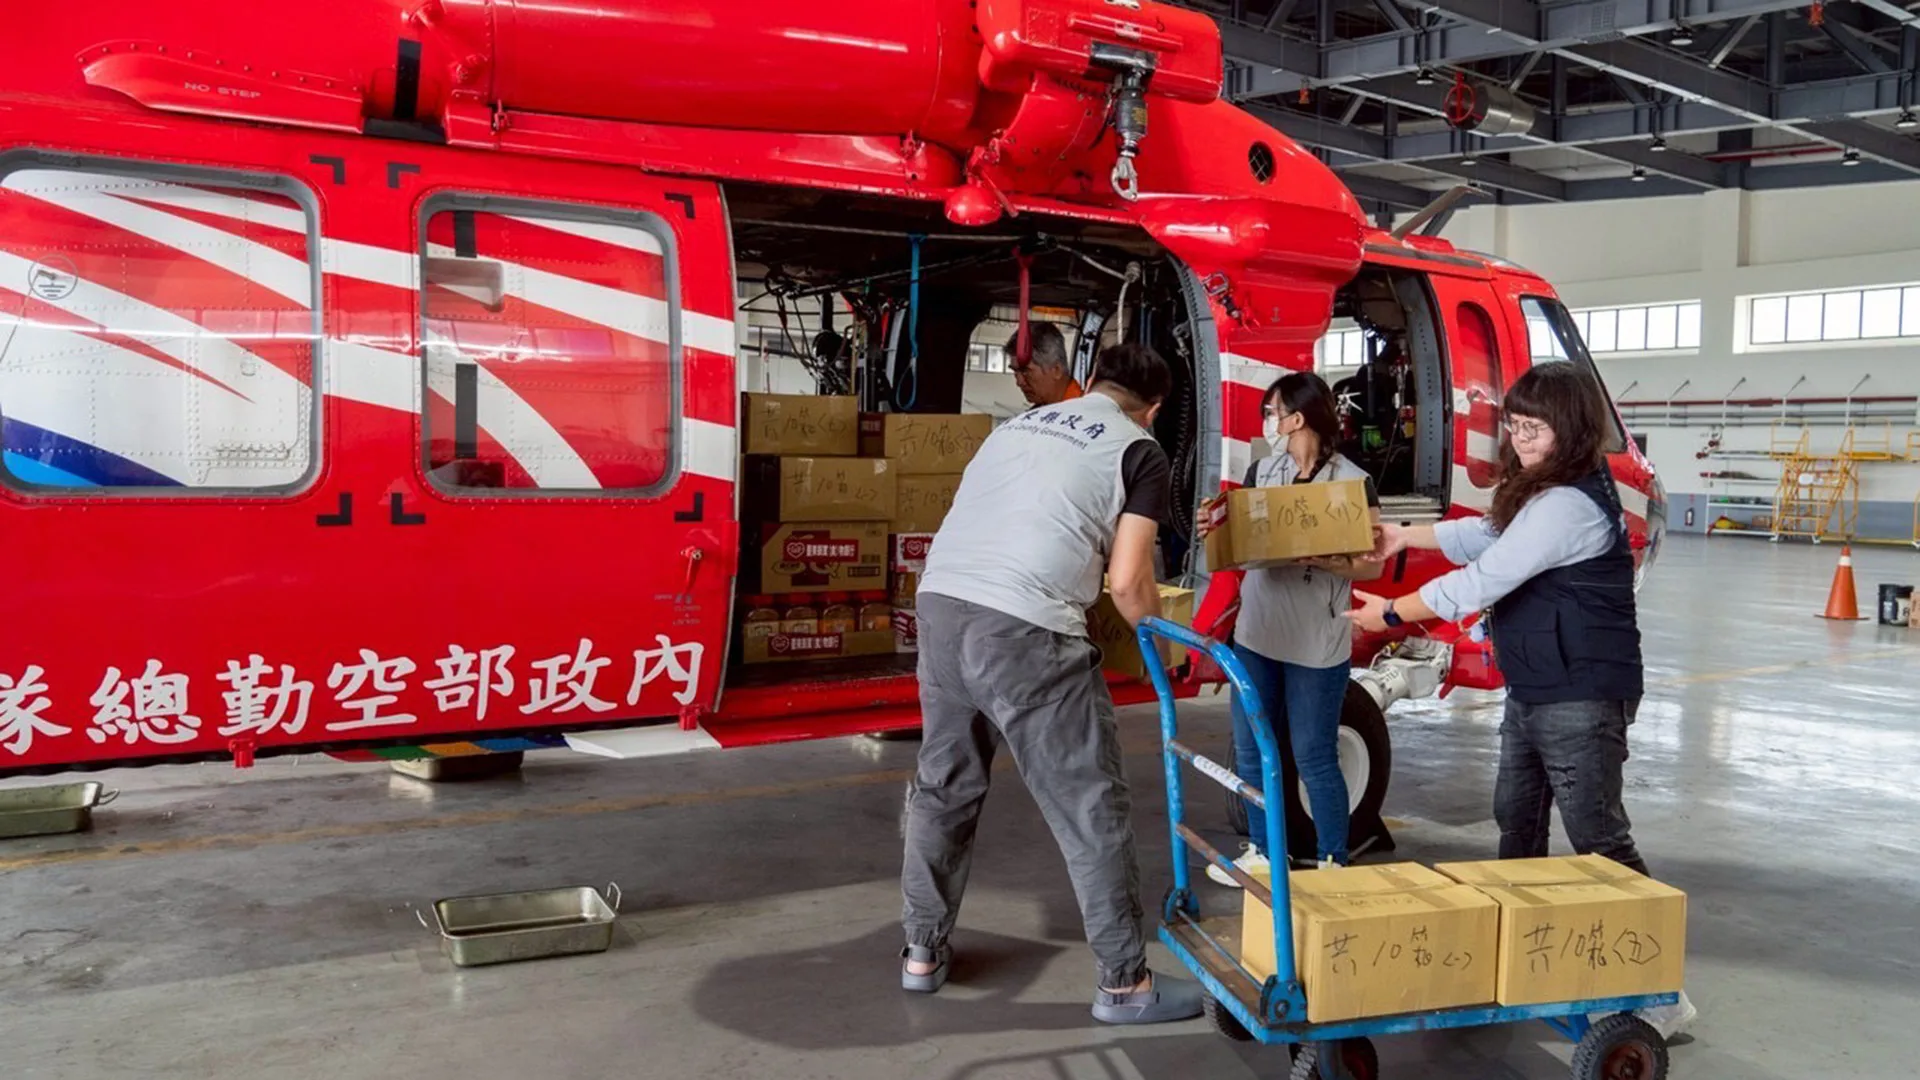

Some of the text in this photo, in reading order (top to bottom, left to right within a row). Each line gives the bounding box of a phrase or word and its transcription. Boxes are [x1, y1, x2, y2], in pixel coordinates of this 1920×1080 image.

[184, 81, 262, 99] NO STEP
[1040, 426, 1089, 450] Government
